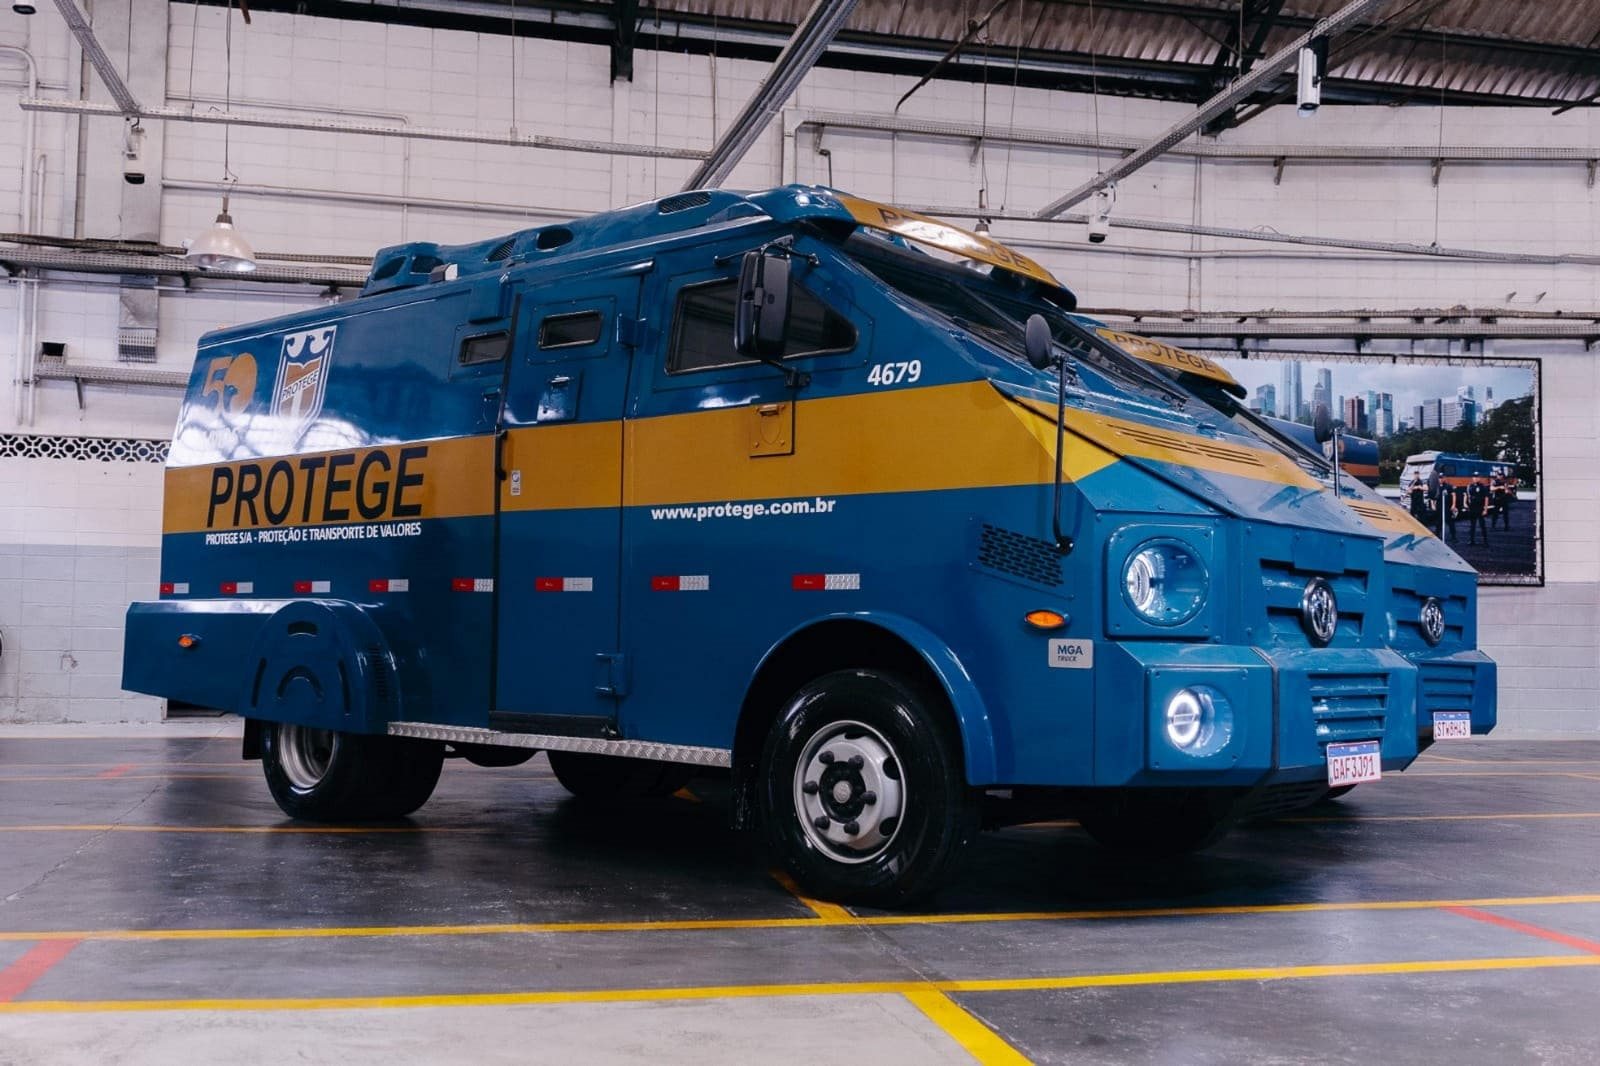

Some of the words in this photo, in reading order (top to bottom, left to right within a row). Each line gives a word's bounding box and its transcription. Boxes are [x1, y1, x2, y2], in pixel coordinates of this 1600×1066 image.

[867, 359, 922, 386] 4679
[281, 371, 319, 400] PROTEGE
[207, 446, 428, 528] PROTEGE
[651, 497, 837, 521] www.protege.com.br
[205, 532, 239, 545] PROTEGE
[239, 531, 253, 544] S/A
[258, 526, 301, 545] PROTEÇÃO
[302, 529, 308, 541] E
[309, 525, 365, 541] TRANSPORTE
[366, 525, 379, 538] DE
[380, 521, 422, 538] VALORES
[1057, 644, 1084, 656] MGA
[1333, 755, 1375, 780] GAF3J91
